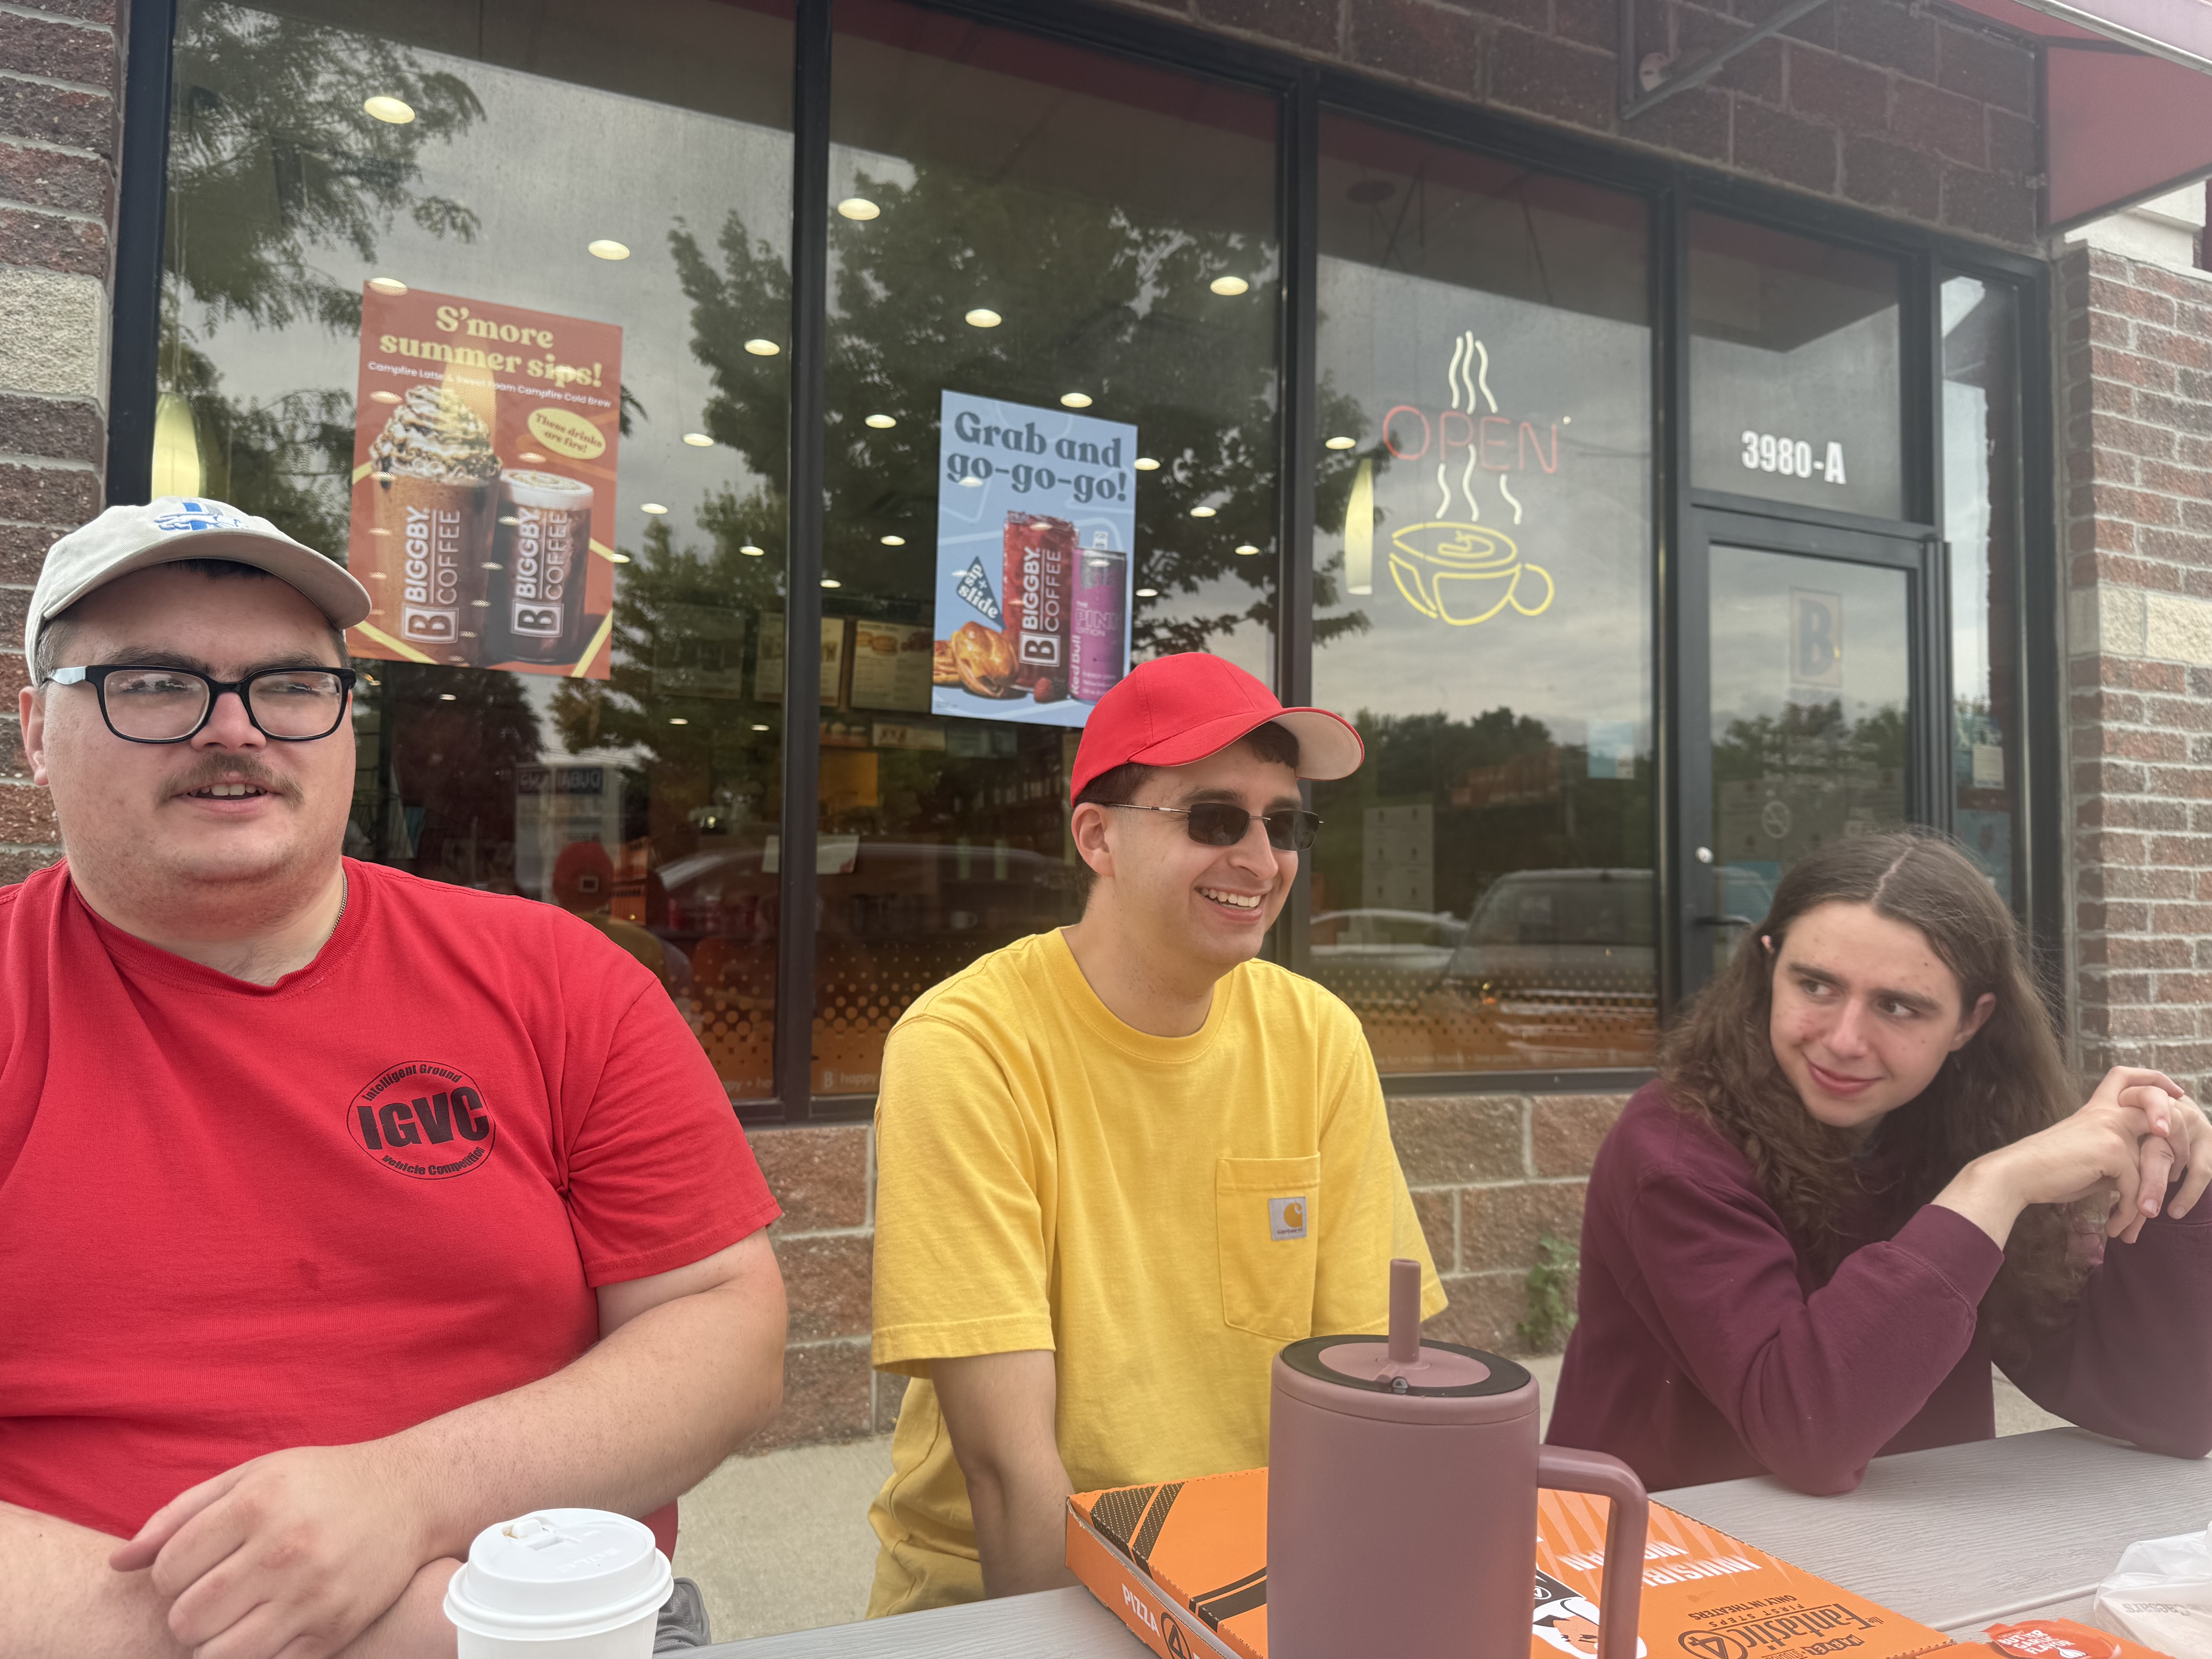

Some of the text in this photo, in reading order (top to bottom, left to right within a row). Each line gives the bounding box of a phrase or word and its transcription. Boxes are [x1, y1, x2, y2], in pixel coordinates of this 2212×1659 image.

[436, 306, 554, 348] S'more
[368, 361, 418, 376] Campfire
[379, 335, 522, 373] summer
[526, 354, 603, 388] sips!
[517, 385, 563, 399] Campfire
[563, 392, 587, 404] Cold
[588, 396, 612, 408] Brew
[567, 428, 603, 447] drinks
[955, 412, 1121, 468] Grab and
[1383, 405, 1557, 474] OPEN
[1741, 430, 1846, 484] 3980-A
[947, 453, 1127, 503] go-go-go!
[404, 505, 429, 603] BIGGBY
[436, 510, 460, 605] COFFEE
[515, 507, 540, 599] BIGGBY
[544, 511, 568, 601] COFFEE
[958, 585, 998, 618] slide
[1022, 546, 1039, 630] BIGGBY
[1045, 550, 1061, 632] COFFEE
[1071, 634, 1081, 695] Red Bull
[362, 1064, 462, 1101] Intelligent Ground
[357, 1086, 490, 1150] IGVC
[382, 1146, 485, 1175] Vehicle Competition
[1641, 1554, 1763, 1588] INVISIBL
[1122, 1583, 1160, 1637] PIZZA
[1688, 1604, 1753, 1620] THEATERS
[1709, 1604, 1805, 1627] FIRST STEPS
[1763, 1595, 1798, 1605] ONLY
[1726, 1604, 1876, 1650] Fantastic
[1765, 1635, 1863, 1659] MARVEL STUDIO
[1997, 1630, 2048, 1645] BUTTER
[2013, 1636, 2059, 1649] GARLIC
[2024, 1640, 2076, 1655] FLAVOR
